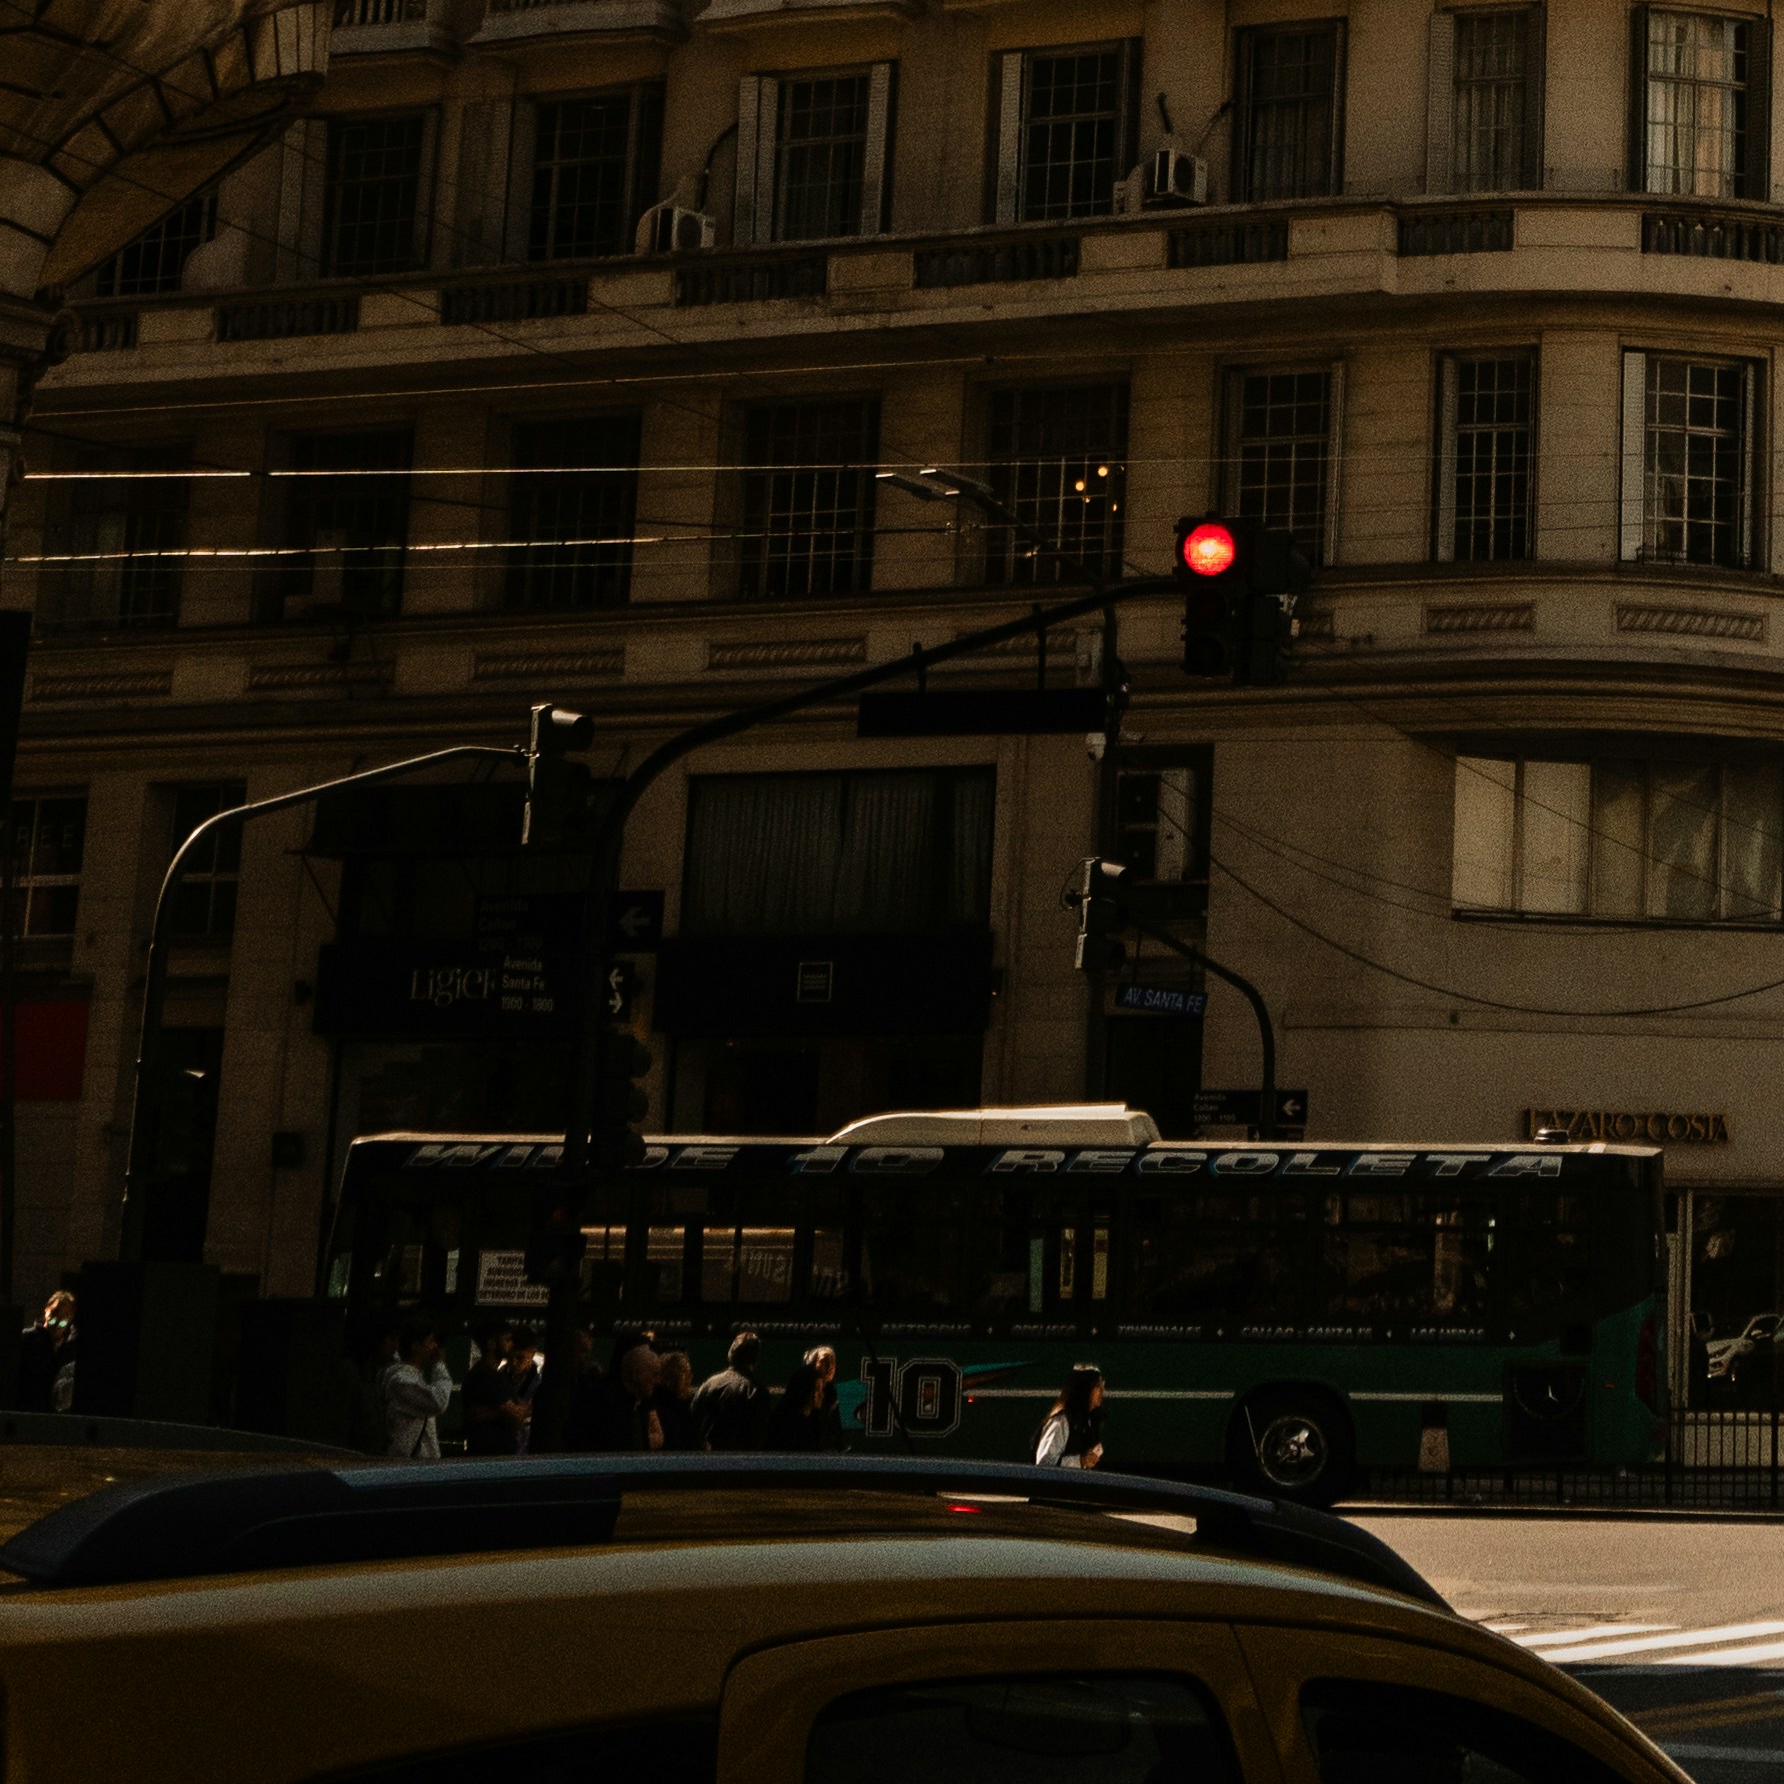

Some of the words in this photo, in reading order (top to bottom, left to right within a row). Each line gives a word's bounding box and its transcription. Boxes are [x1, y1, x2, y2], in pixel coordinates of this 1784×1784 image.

[503, 954, 543, 972] Avenida
[501, 973, 531, 990] Santa
[533, 975, 546, 991] Fe
[1122, 986, 1142, 1005] AV.
[1144, 989, 1183, 1010] SANTA
[1186, 995, 1203, 1013] FE
[1525, 1109, 1637, 1142] LAZARO
[1647, 1113, 1728, 1142] COSTA
[795, 1146, 945, 1174] 10
[990, 1149, 1564, 1178] RECOLETA
[861, 1357, 962, 1438] 10
